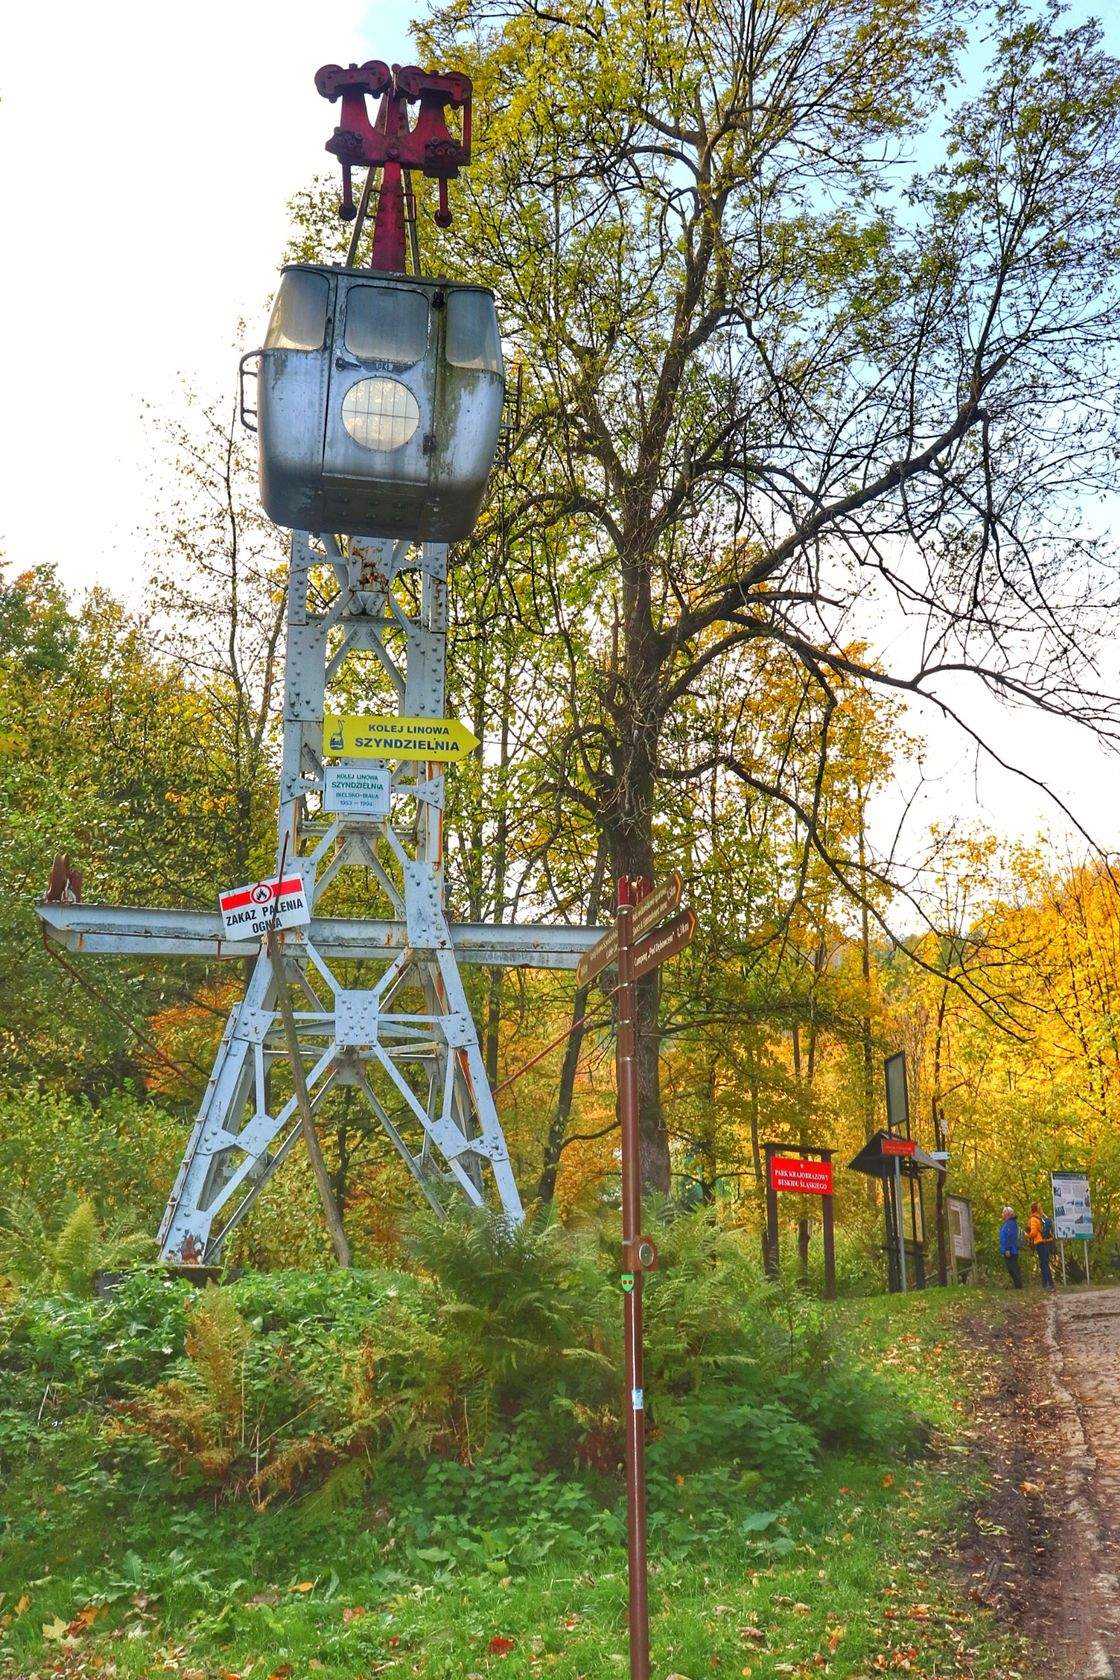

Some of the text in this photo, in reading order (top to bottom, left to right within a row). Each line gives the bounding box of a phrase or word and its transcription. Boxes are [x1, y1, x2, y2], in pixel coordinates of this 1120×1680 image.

[368, 724, 450, 735] KOLEJ LINOWA
[355, 737, 460, 751] SZYNDZIELNIA
[331, 782, 384, 790] SZYNDZIELNIA
[225, 909, 257, 927] ZAKAZ
[252, 917, 282, 934] OGNA
[774, 1169, 829, 1181] PARK KRAJOBRAZOWY
[777, 1178, 828, 1190] BESKIDU ŚLĄSKIEGO
